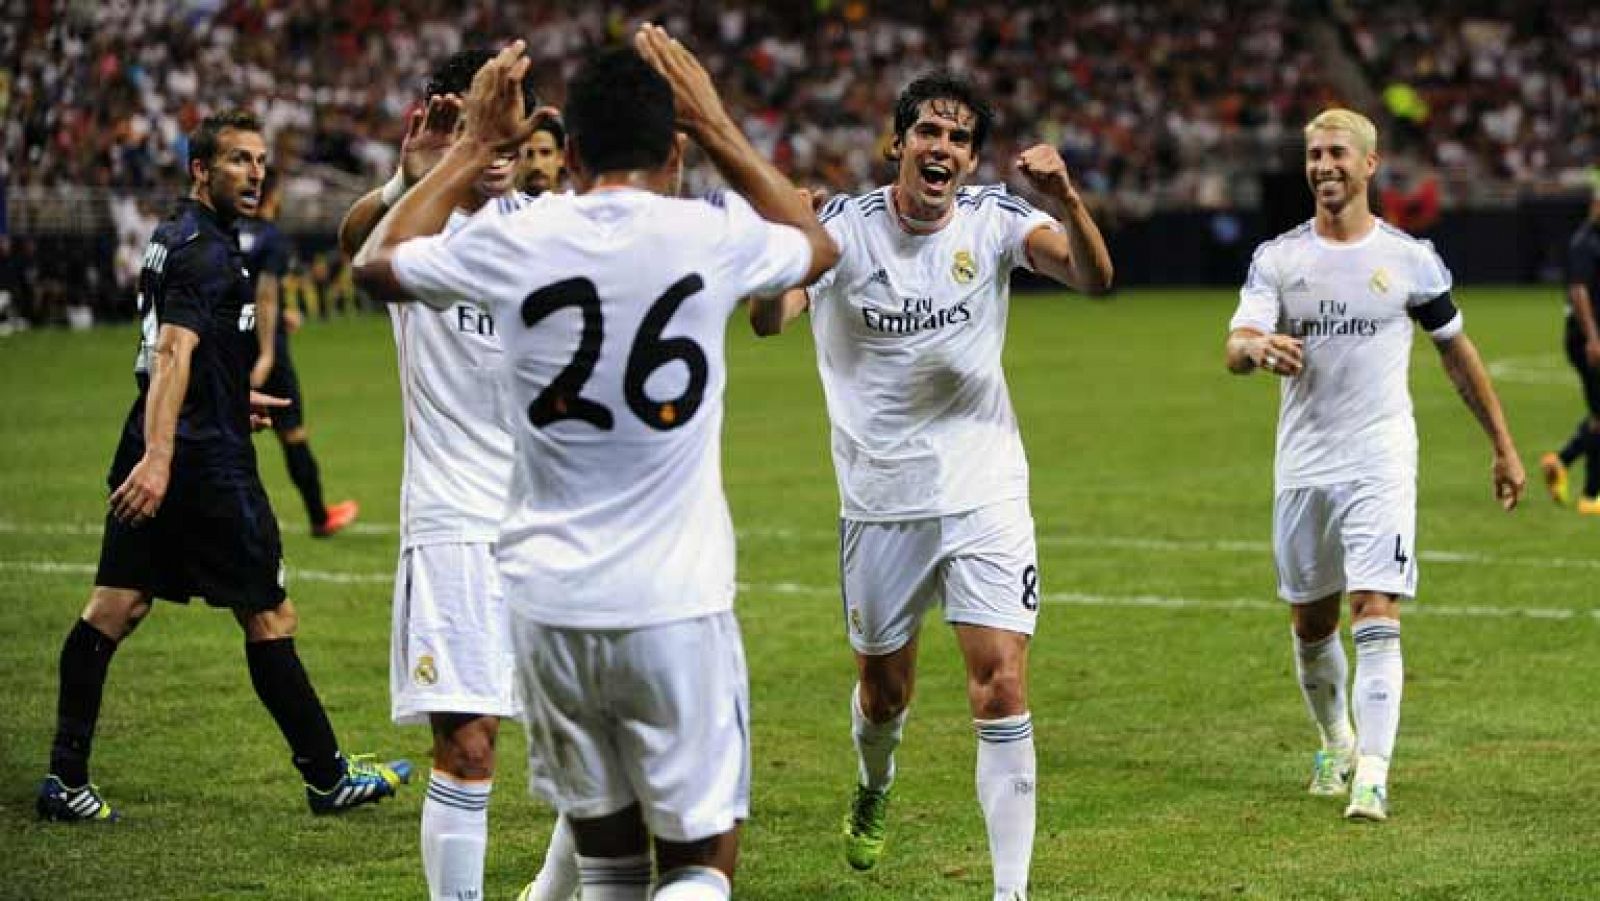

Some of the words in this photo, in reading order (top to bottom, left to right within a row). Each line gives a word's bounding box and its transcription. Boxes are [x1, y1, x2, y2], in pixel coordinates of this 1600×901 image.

[862, 302, 970, 334] Emirates
[903, 296, 932, 314] Fly
[1319, 299, 1347, 316] Fly
[521, 272, 709, 431] 26
[1394, 533, 1408, 575] 4
[1022, 564, 1037, 611] 8
